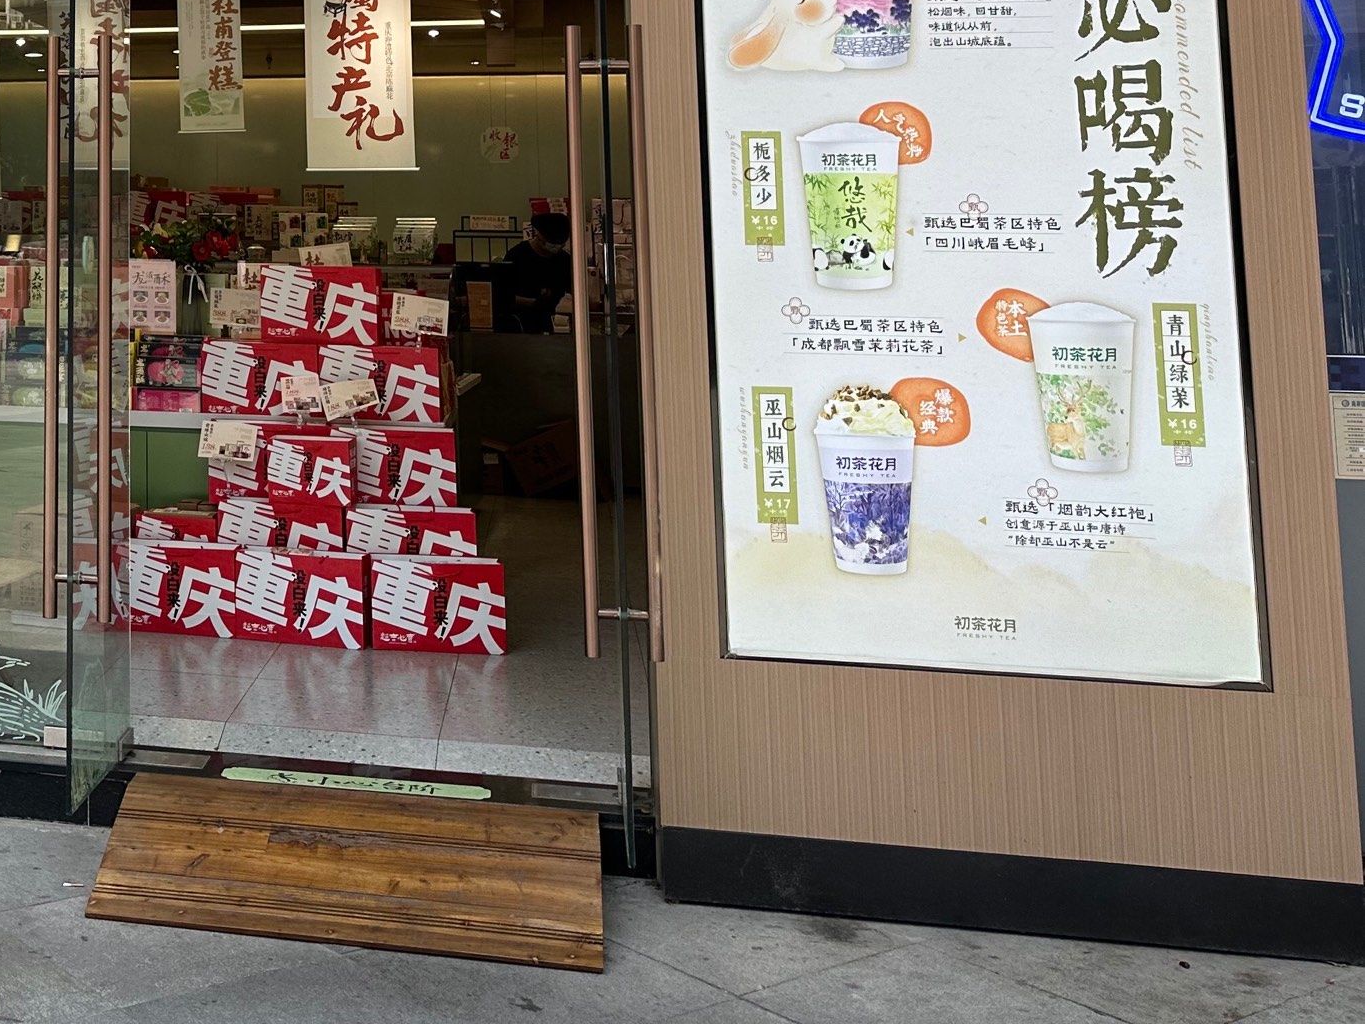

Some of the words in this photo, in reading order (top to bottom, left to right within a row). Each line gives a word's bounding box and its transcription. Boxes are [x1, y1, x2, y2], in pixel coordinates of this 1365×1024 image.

[821, 152, 878, 167] 初茶花月
[752, 141, 773, 206] 栀多少
[838, 175, 873, 233] 悠哉
[751, 215, 778, 226] ¥16
[924, 215, 1062, 232] 甄选巴蜀茶区特色
[925, 236, 1045, 253] 「四川峨眉毛峰」
[260, 265, 378, 346] 重庆
[808, 318, 944, 334] 甄选巴蜀茶区特色
[1009, 300, 1028, 337] 本土
[791, 337, 944, 355] 「成都飘雪茉莉花茶」
[1051, 346, 1118, 362] 初茶花月
[1166, 314, 1190, 409] 青山绿茉
[934, 388, 955, 424] 爆款
[920, 401, 939, 435] 经典
[1167, 418, 1198, 430] ¥16
[765, 398, 785, 488] 巫山烟云
[267, 439, 351, 507] 重庆
[836, 455, 897, 472] 初茶花月
[763, 497, 791, 509] ¥17
[1005, 500, 1155, 523] 甄选「烟韵大红袍」
[1005, 518, 1126, 536] 创意源于巫山和唐诗
[116, 543, 236, 639] 重庆
[235, 550, 364, 650] 重庆
[371, 559, 507, 656] 重庆
[954, 616, 1017, 634] 初茶花月
